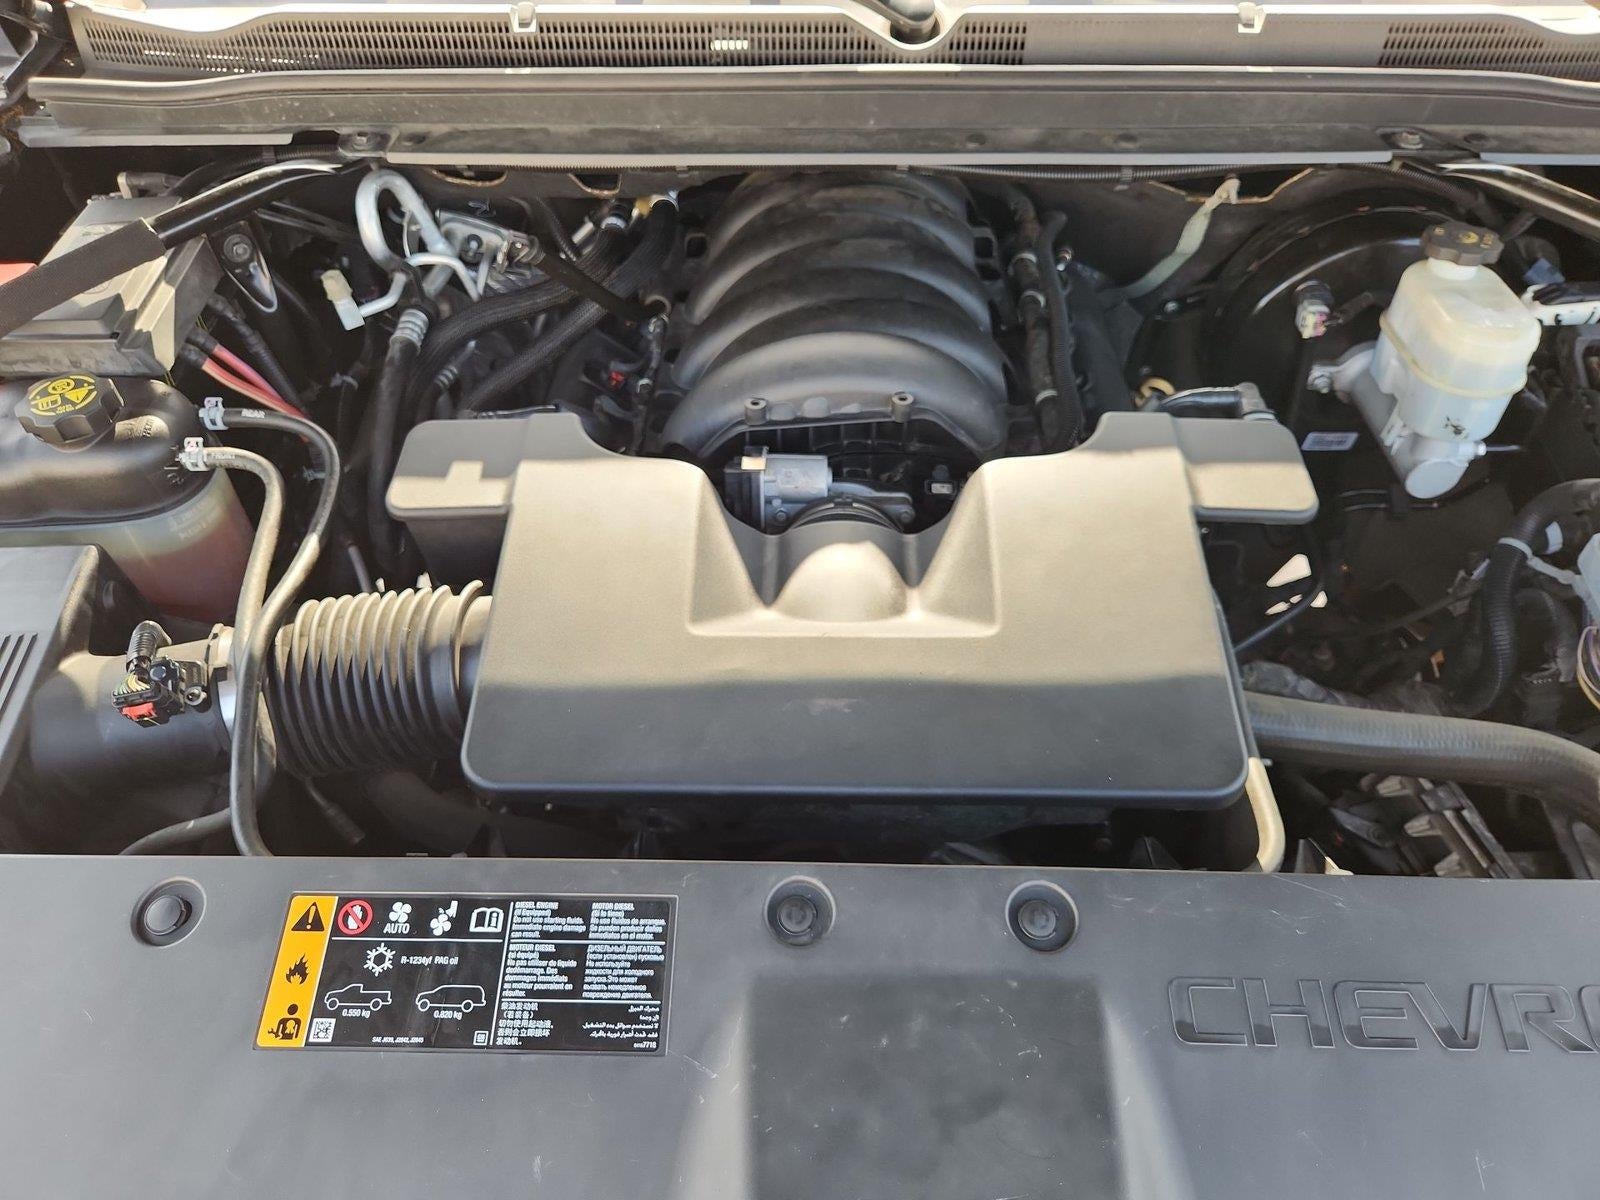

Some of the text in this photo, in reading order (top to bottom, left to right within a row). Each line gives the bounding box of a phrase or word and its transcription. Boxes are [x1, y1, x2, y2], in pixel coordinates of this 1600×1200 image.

[614, 903, 634, 911] DIESEL
[383, 923, 410, 934] AUTO
[543, 924, 562, 932] engine
[562, 924, 586, 933] damage
[587, 944, 662, 953] ДИЗЕЛЬНЫЙ ДВИГАТЕЛЬ
[400, 956, 459, 966] R-1234yf PAG oil
[342, 1009, 370, 1018] 0.550 kg
